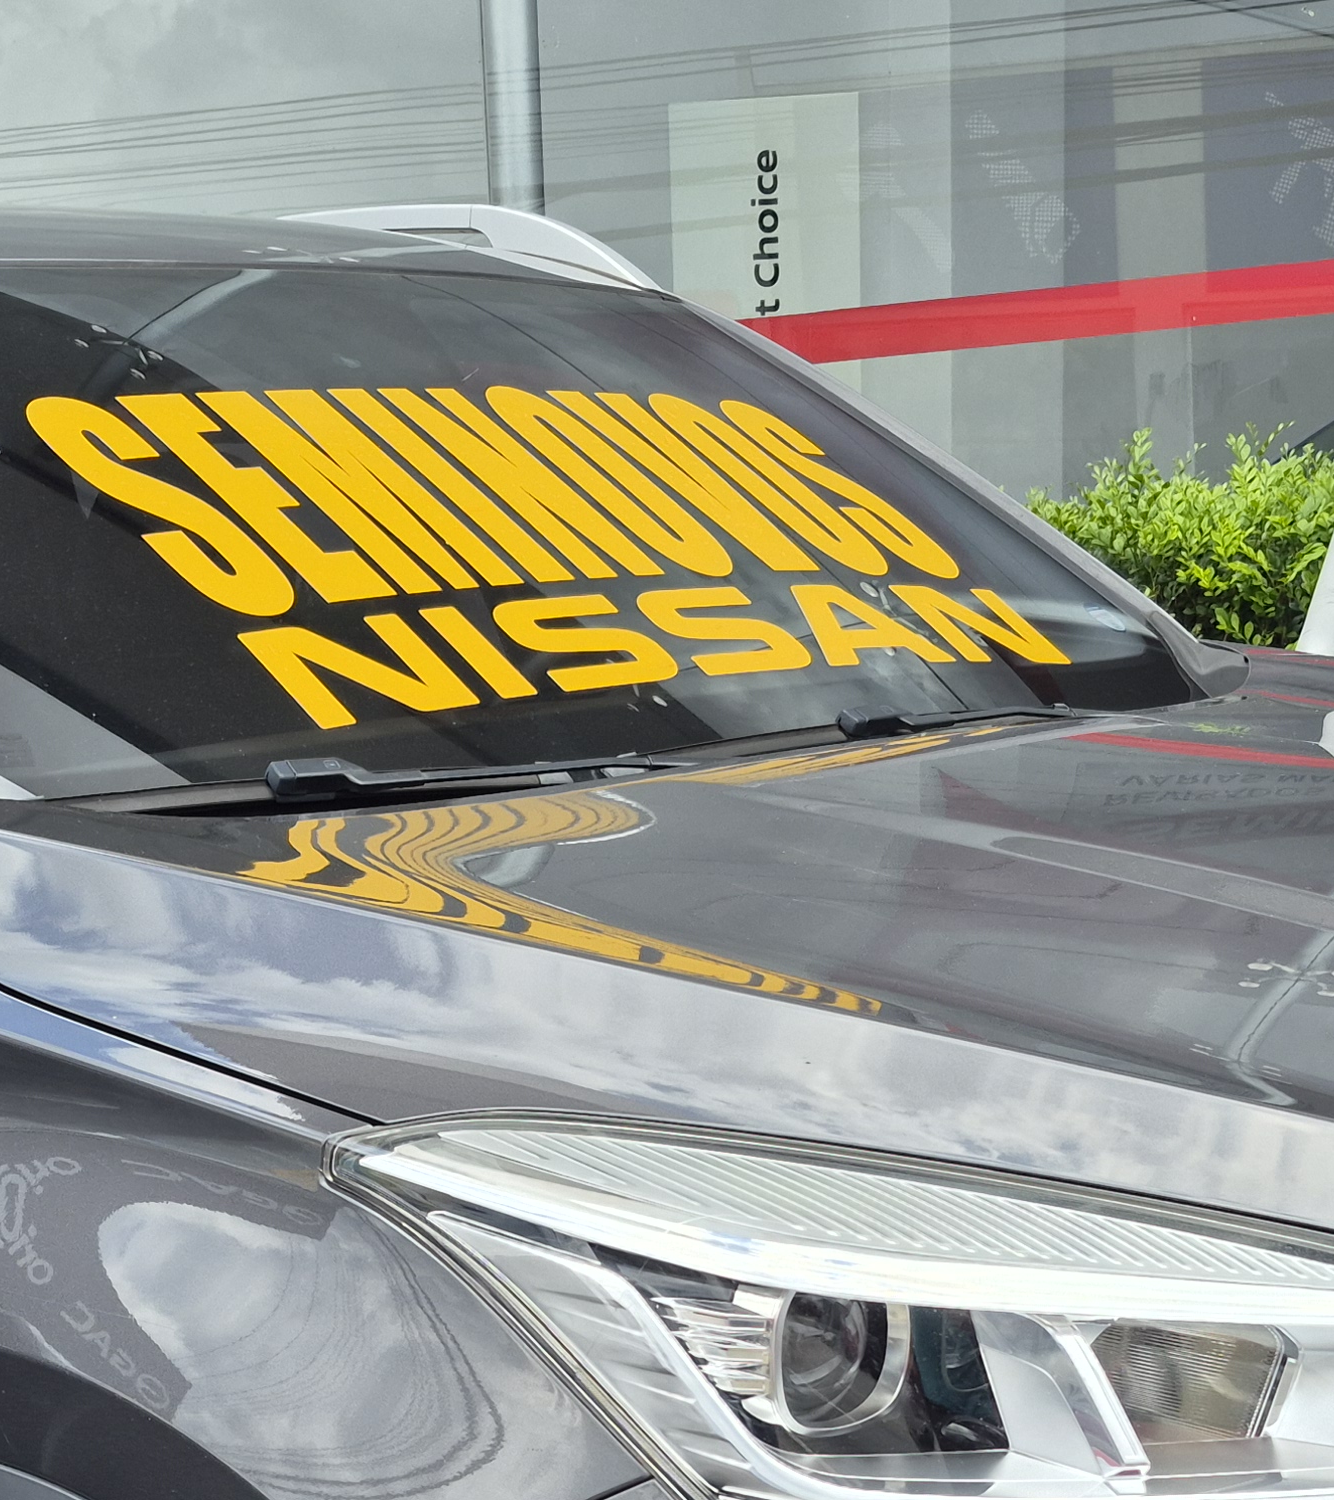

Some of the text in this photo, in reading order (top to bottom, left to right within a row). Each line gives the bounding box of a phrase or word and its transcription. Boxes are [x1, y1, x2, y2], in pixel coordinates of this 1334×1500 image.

[750, 149, 780, 288] Choice
[26, 386, 960, 617] SEMINOVOS
[237, 584, 1072, 730] NISSAN
